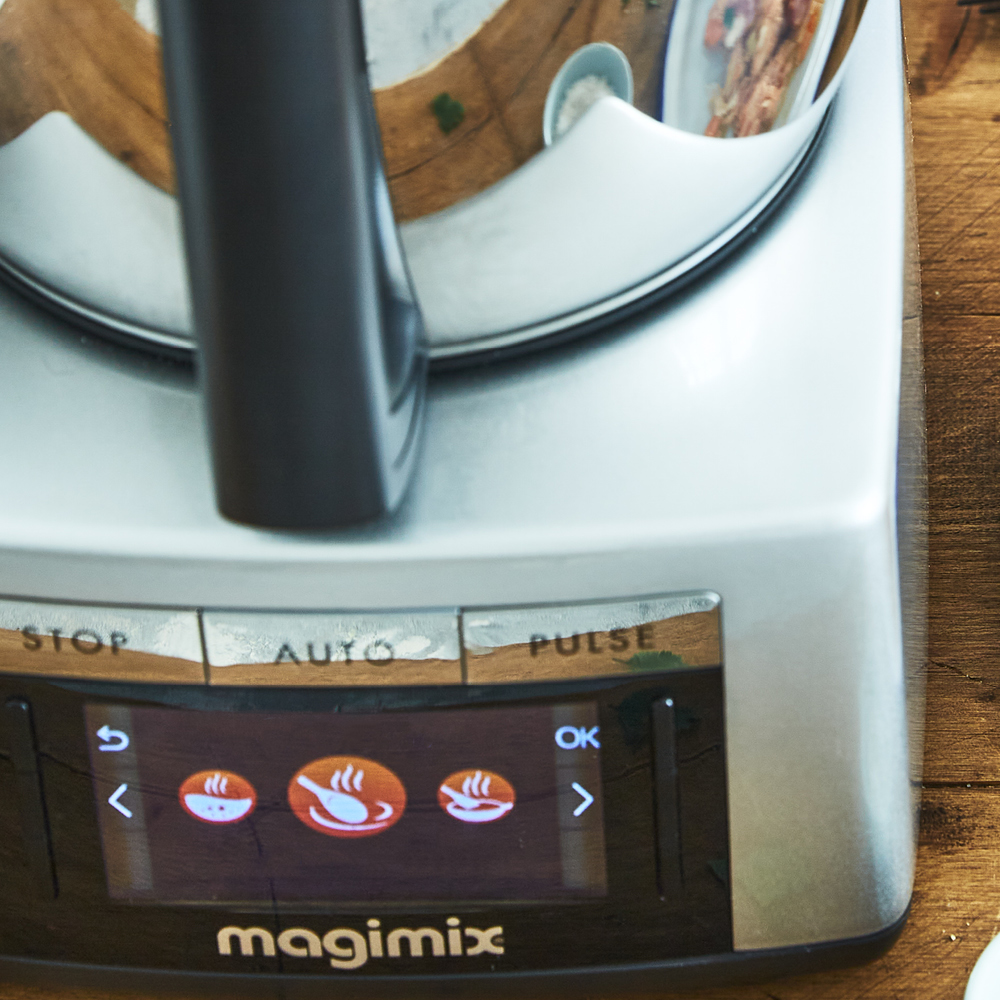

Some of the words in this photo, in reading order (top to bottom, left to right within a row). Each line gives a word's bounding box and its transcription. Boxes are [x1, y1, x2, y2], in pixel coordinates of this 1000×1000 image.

[22, 625, 128, 656] STOP
[274, 640, 395, 667] AUTO
[529, 625, 656, 658] PULSE
[555, 725, 600, 749] OK
[217, 917, 504, 970] magimix
